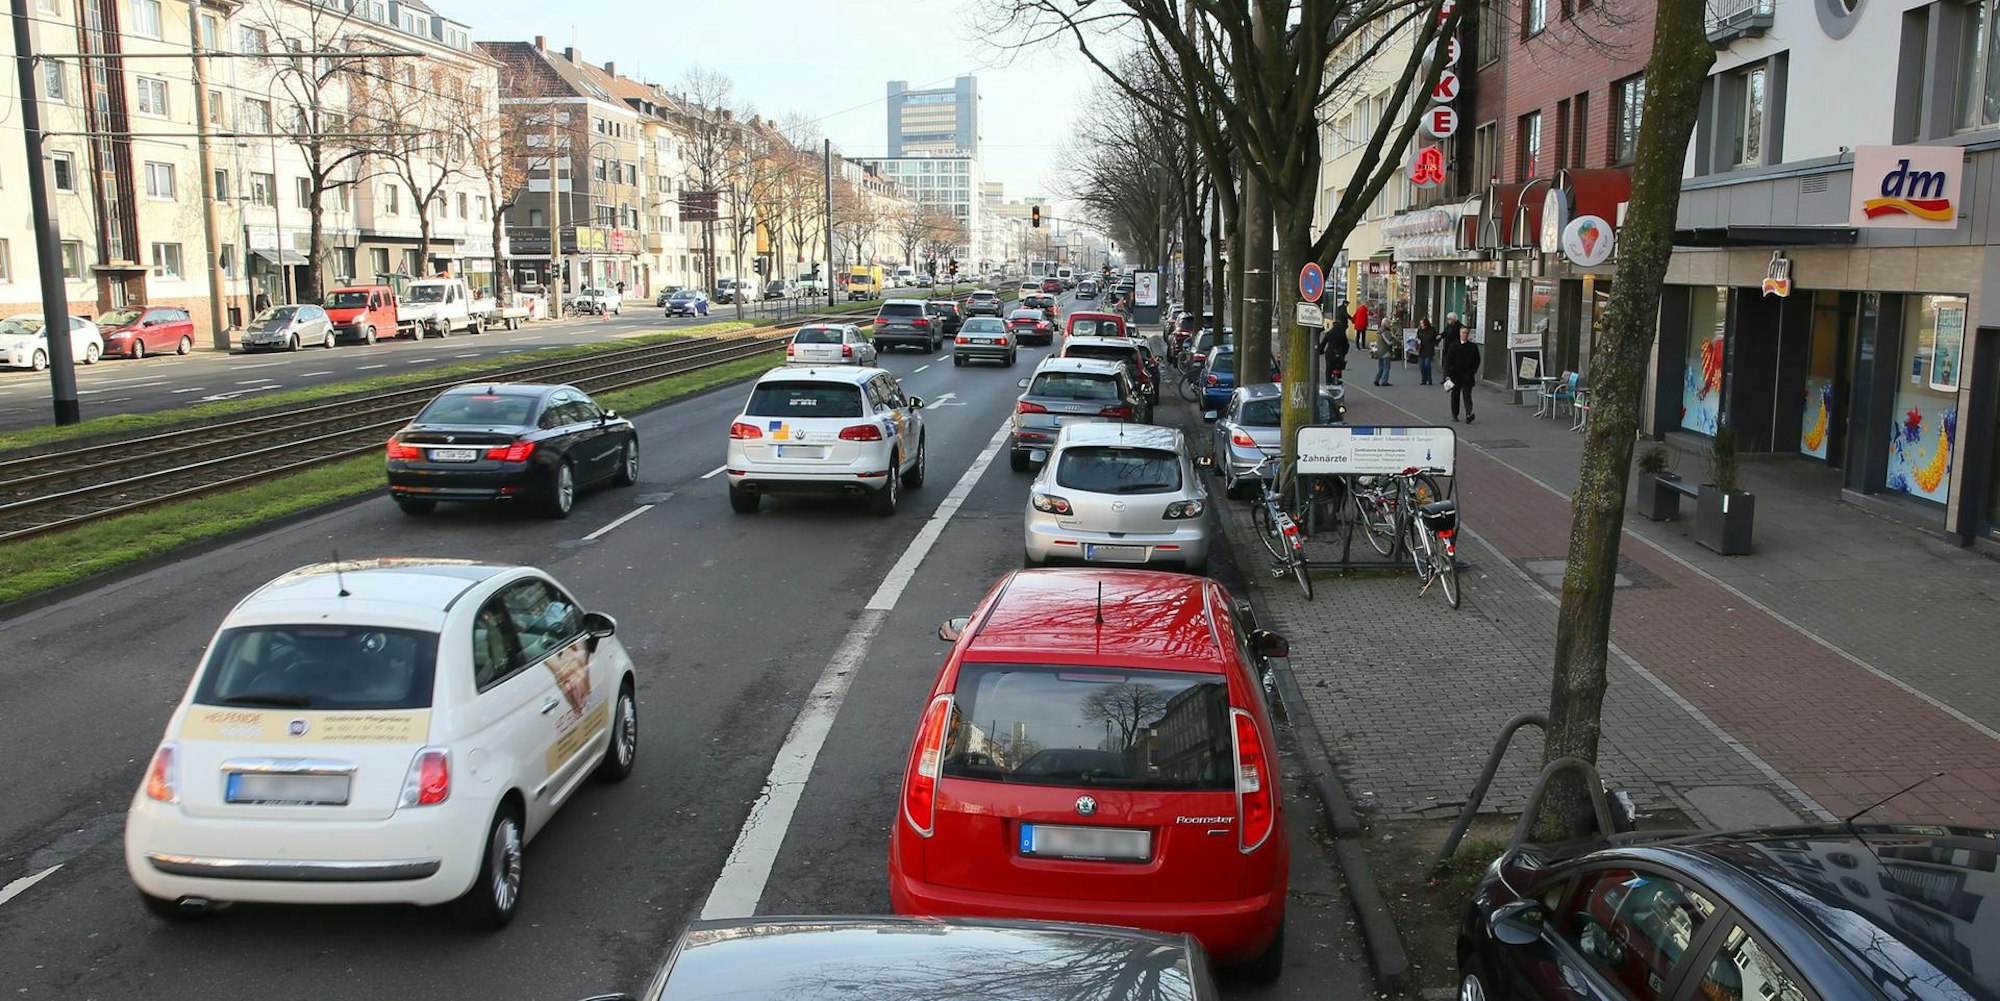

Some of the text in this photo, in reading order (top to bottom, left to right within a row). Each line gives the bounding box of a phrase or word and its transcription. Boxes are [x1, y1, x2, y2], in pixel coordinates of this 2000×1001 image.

[1881, 159, 1947, 198] dm
[1769, 252, 1787, 279] dm
[1302, 453, 1348, 463] Zahnärzte
[1176, 815, 1235, 825] Roomster
